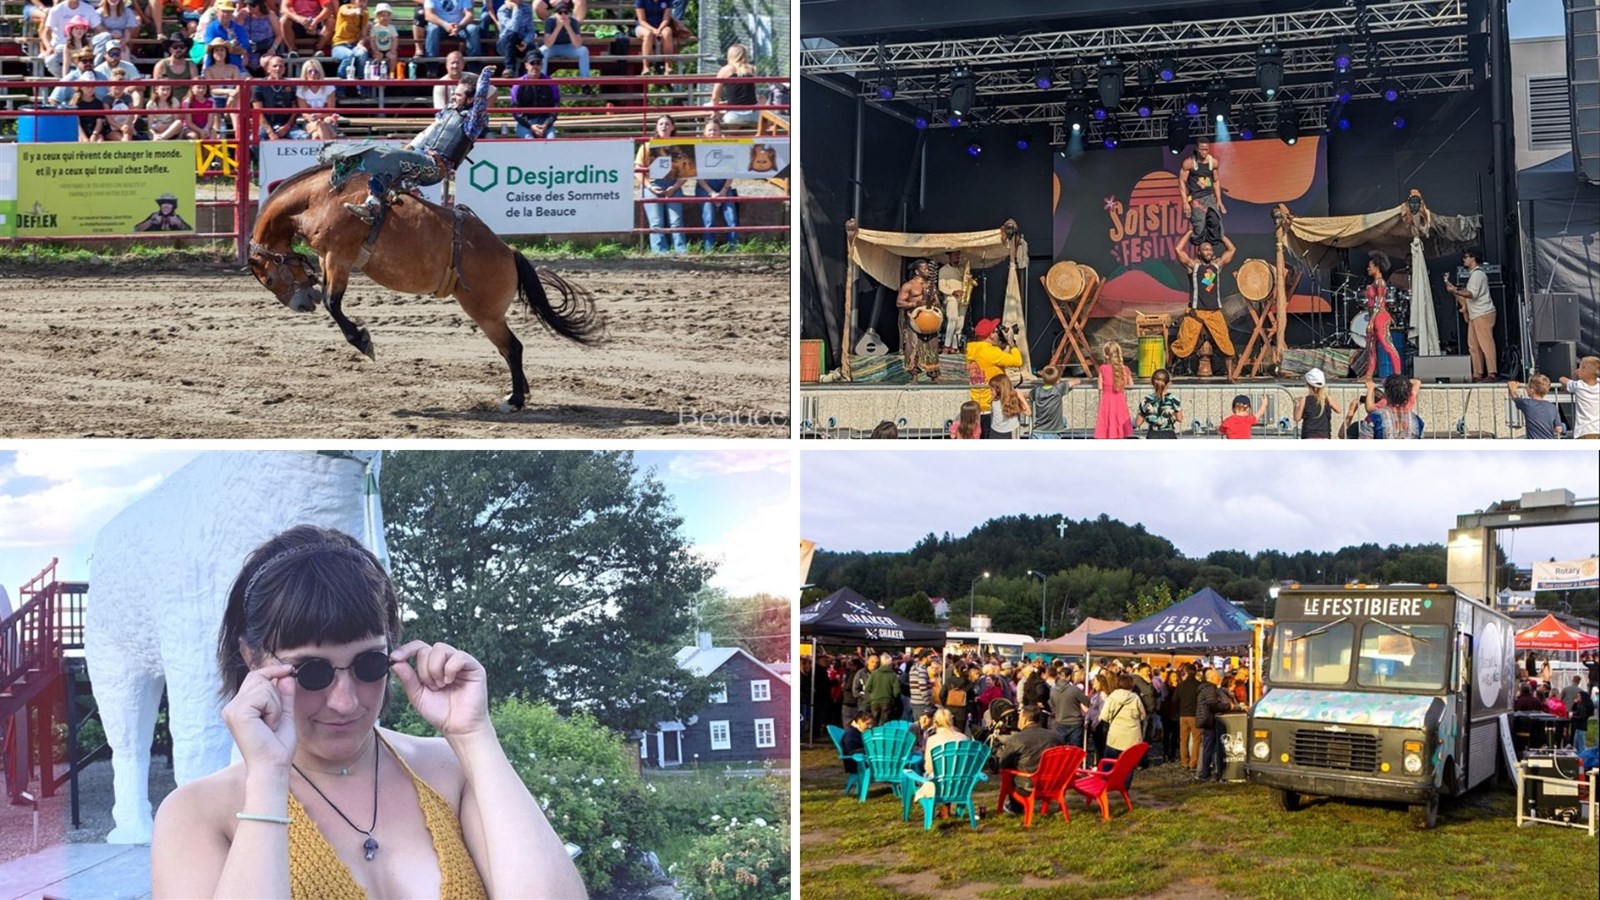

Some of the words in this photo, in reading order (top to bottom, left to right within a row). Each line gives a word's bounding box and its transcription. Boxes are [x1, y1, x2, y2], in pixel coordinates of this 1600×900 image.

[30, 154, 34, 163] y
[42, 152, 60, 160] ceux
[62, 151, 74, 162] qui
[76, 150, 101, 160] rêvent
[103, 150, 112, 159] de
[114, 150, 144, 161] changer
[145, 150, 152, 158] le
[154, 149, 182, 158] monde.
[277, 147, 298, 156] LES
[36, 167, 45, 176] et
[46, 166, 51, 175] il
[52, 168, 58, 178] y
[85, 166, 97, 177] qui
[98, 165, 123, 175] travail
[125, 165, 142, 174] chez
[143, 164, 170, 174] Deflex.
[506, 164, 618, 189] Desjardins
[506, 192, 542, 202] Caisse
[545, 190, 565, 202] des
[567, 190, 620, 201] Sommets
[506, 207, 520, 218] de
[523, 207, 532, 217] la
[536, 206, 576, 217] Beauce
[16, 214, 58, 228] DEFLEX
[1110, 199, 1192, 242] SOLSTIC
[1304, 598, 1320, 614] LE
[842, 613, 898, 626] SHAKER
[1161, 616, 1178, 624] JE
[1180, 616, 1213, 626] BOIS
[878, 628, 904, 639] SHAKER
[1123, 634, 1135, 646] JE
[1139, 633, 1166, 644] BOIS
[1171, 632, 1209, 643] LOCAL
